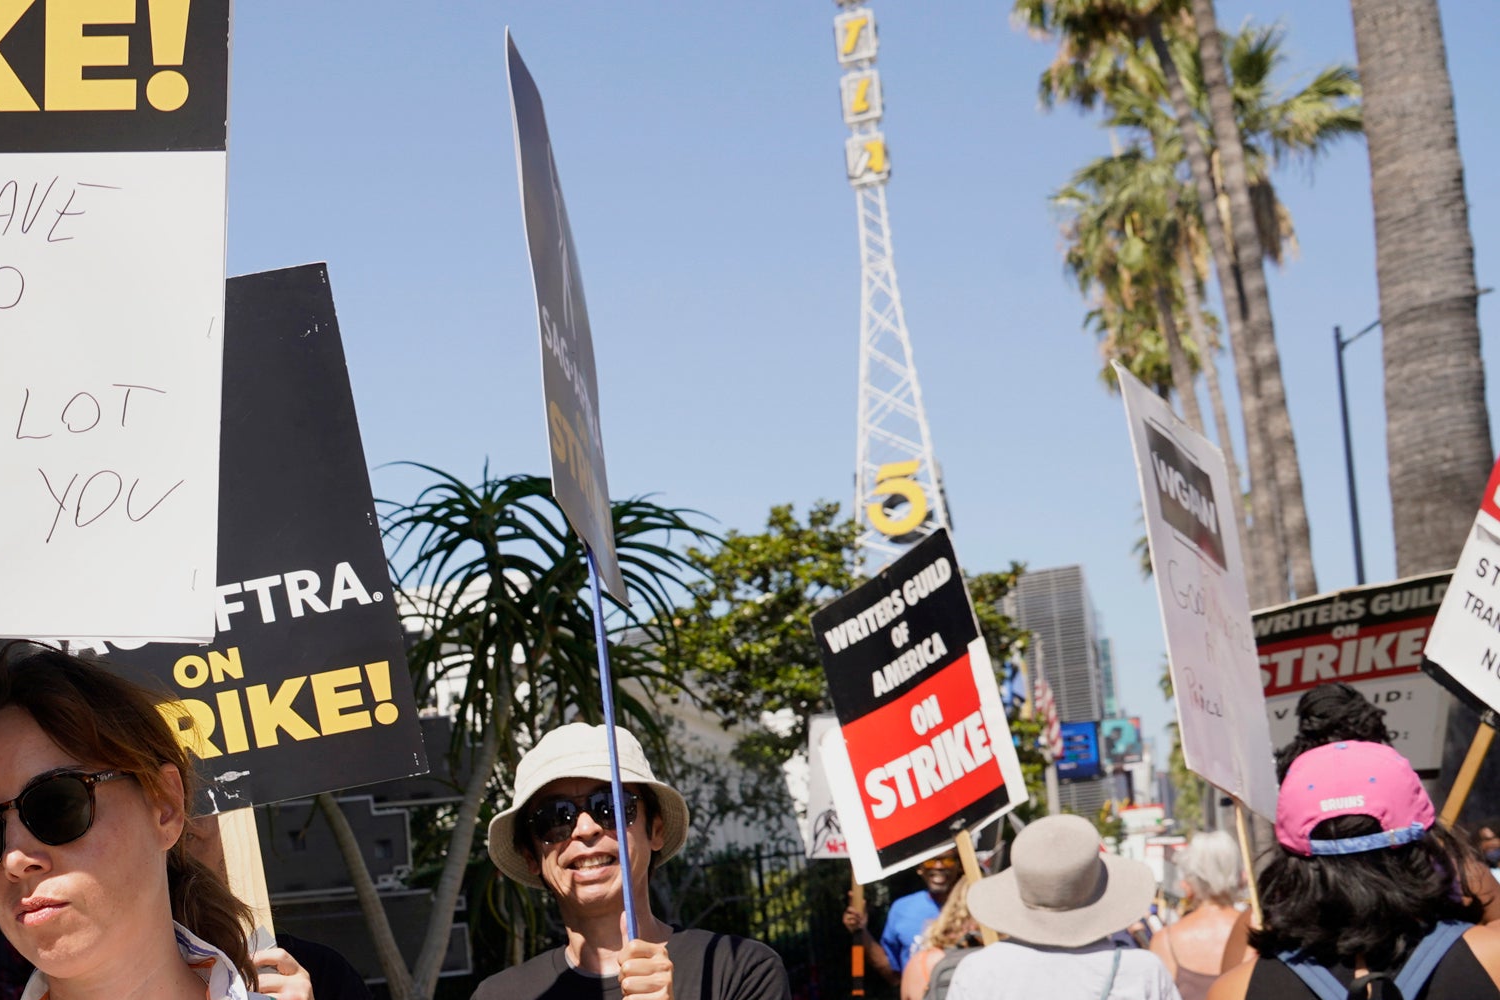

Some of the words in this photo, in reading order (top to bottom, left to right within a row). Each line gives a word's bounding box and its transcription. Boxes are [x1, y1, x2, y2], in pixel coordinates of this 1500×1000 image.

[15, 383, 166, 440] LOT
[38, 469, 184, 543] YOU
[867, 460, 928, 537] 5
[824, 589, 906, 654] WRITERS
[903, 557, 952, 606] GUILD
[1252, 597, 1367, 638] WRITERS
[1331, 623, 1359, 639] ON
[891, 621, 910, 648] OF
[173, 647, 244, 688] ON
[871, 632, 948, 698] AMERICA
[155, 660, 399, 760] RIKE!
[910, 694, 944, 736] ON
